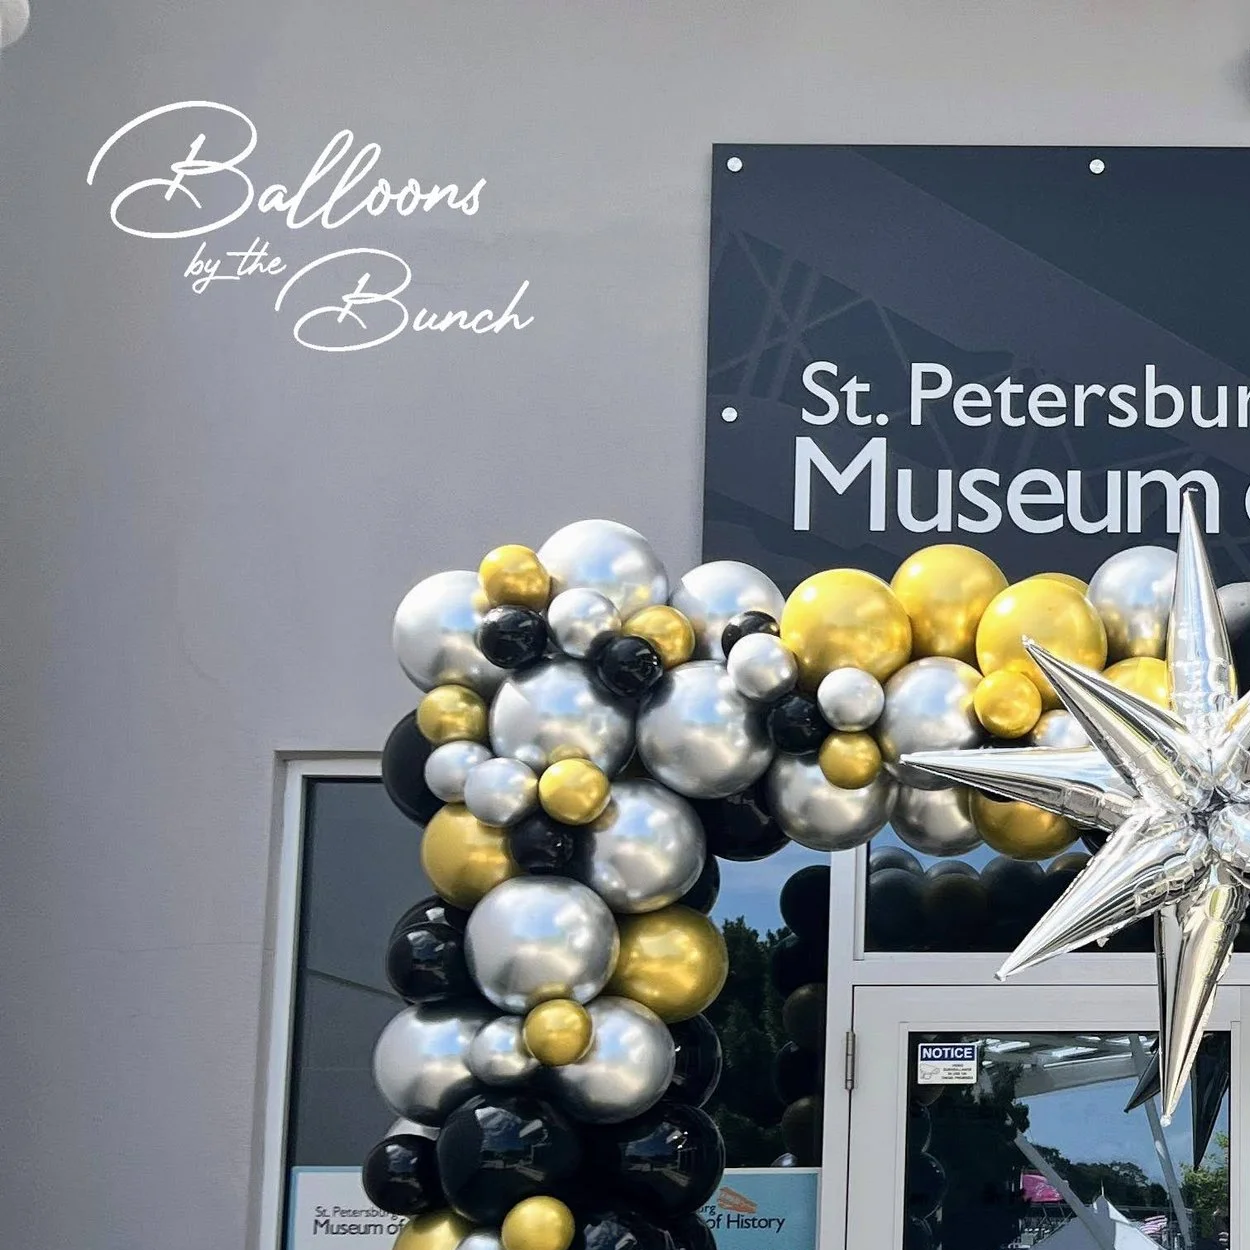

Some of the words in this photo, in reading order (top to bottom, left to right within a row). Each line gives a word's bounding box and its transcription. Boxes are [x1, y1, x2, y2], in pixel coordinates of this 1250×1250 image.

[801, 361, 889, 426] St.
[794, 436, 1220, 534] Museum
[922, 1047, 973, 1059] NOTICE
[313, 1219, 383, 1235] Museum
[706, 1214, 722, 1230] of
[726, 1214, 786, 1233] History
